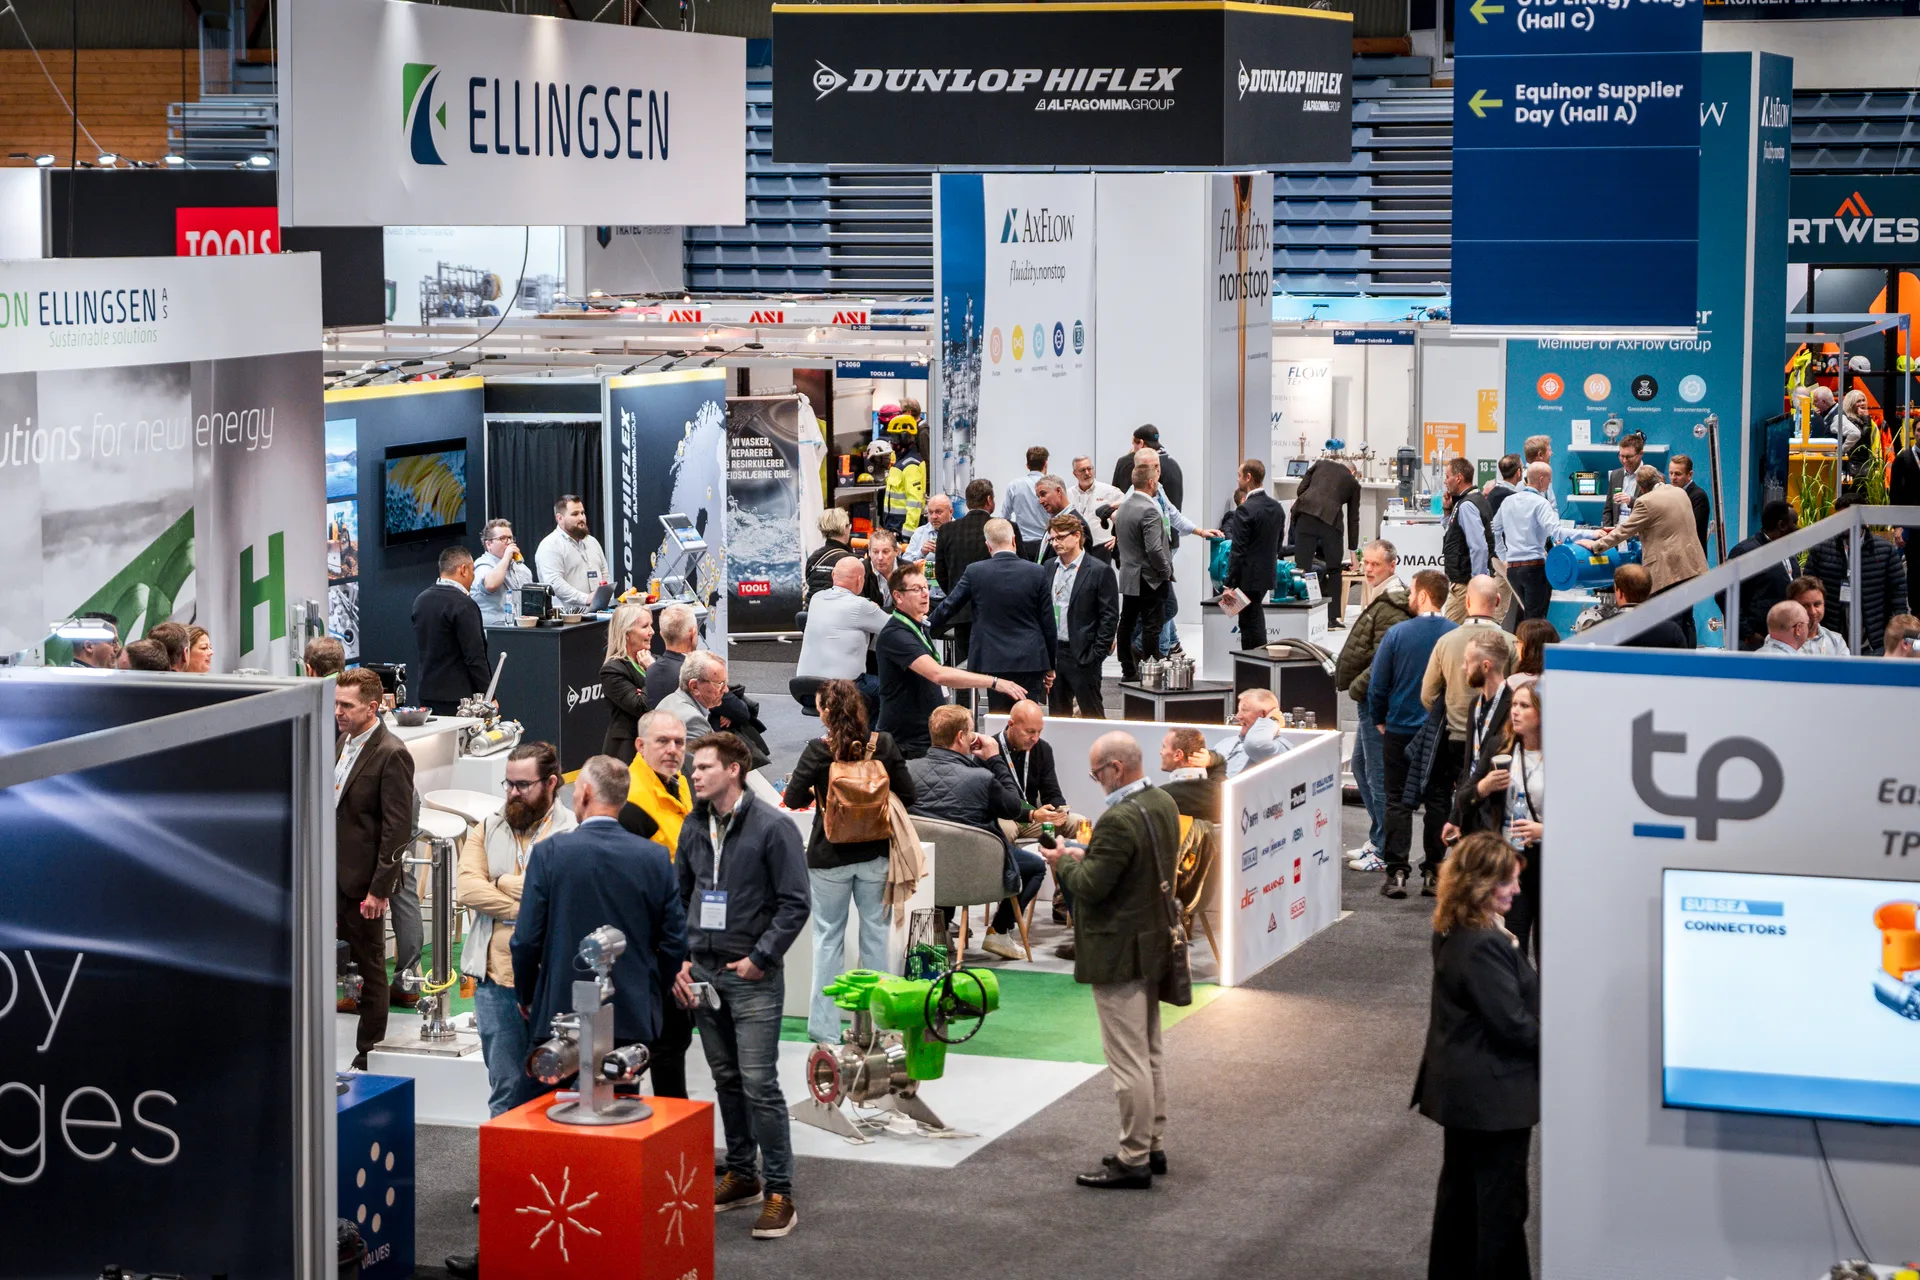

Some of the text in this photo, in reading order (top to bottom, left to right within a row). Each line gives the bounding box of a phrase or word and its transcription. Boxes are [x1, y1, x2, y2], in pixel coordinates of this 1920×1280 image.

[1517, 7, 1595, 33] (Hall C)
[1515, 81, 1684, 105] Equinor Supplier
[469, 77, 669, 160] ELLINGSEN
[1515, 100, 1637, 128] Day (Hall A)
[1219, 208, 1270, 265] fluidity.
[1219, 266, 1269, 307] nonstop
[39, 288, 157, 326] ELLINGSEN
[49, 326, 158, 348] Sustainable solutions
[1537, 339, 1594, 350] Member
[1669, 339, 1712, 353] Group
[91, 412, 128, 459] for
[135, 416, 187, 455] new
[196, 407, 275, 451] energy
[732, 437, 772, 447] VI VASKER,
[731, 448, 774, 458] REPARERER
[731, 459, 784, 469] RESIRKULERER
[774, 469, 793, 479] DINE.
[741, 584, 769, 593] TOOLS
[1684, 897, 1750, 914] SUBSEA
[1684, 919, 1787, 936] CONNECTORS
